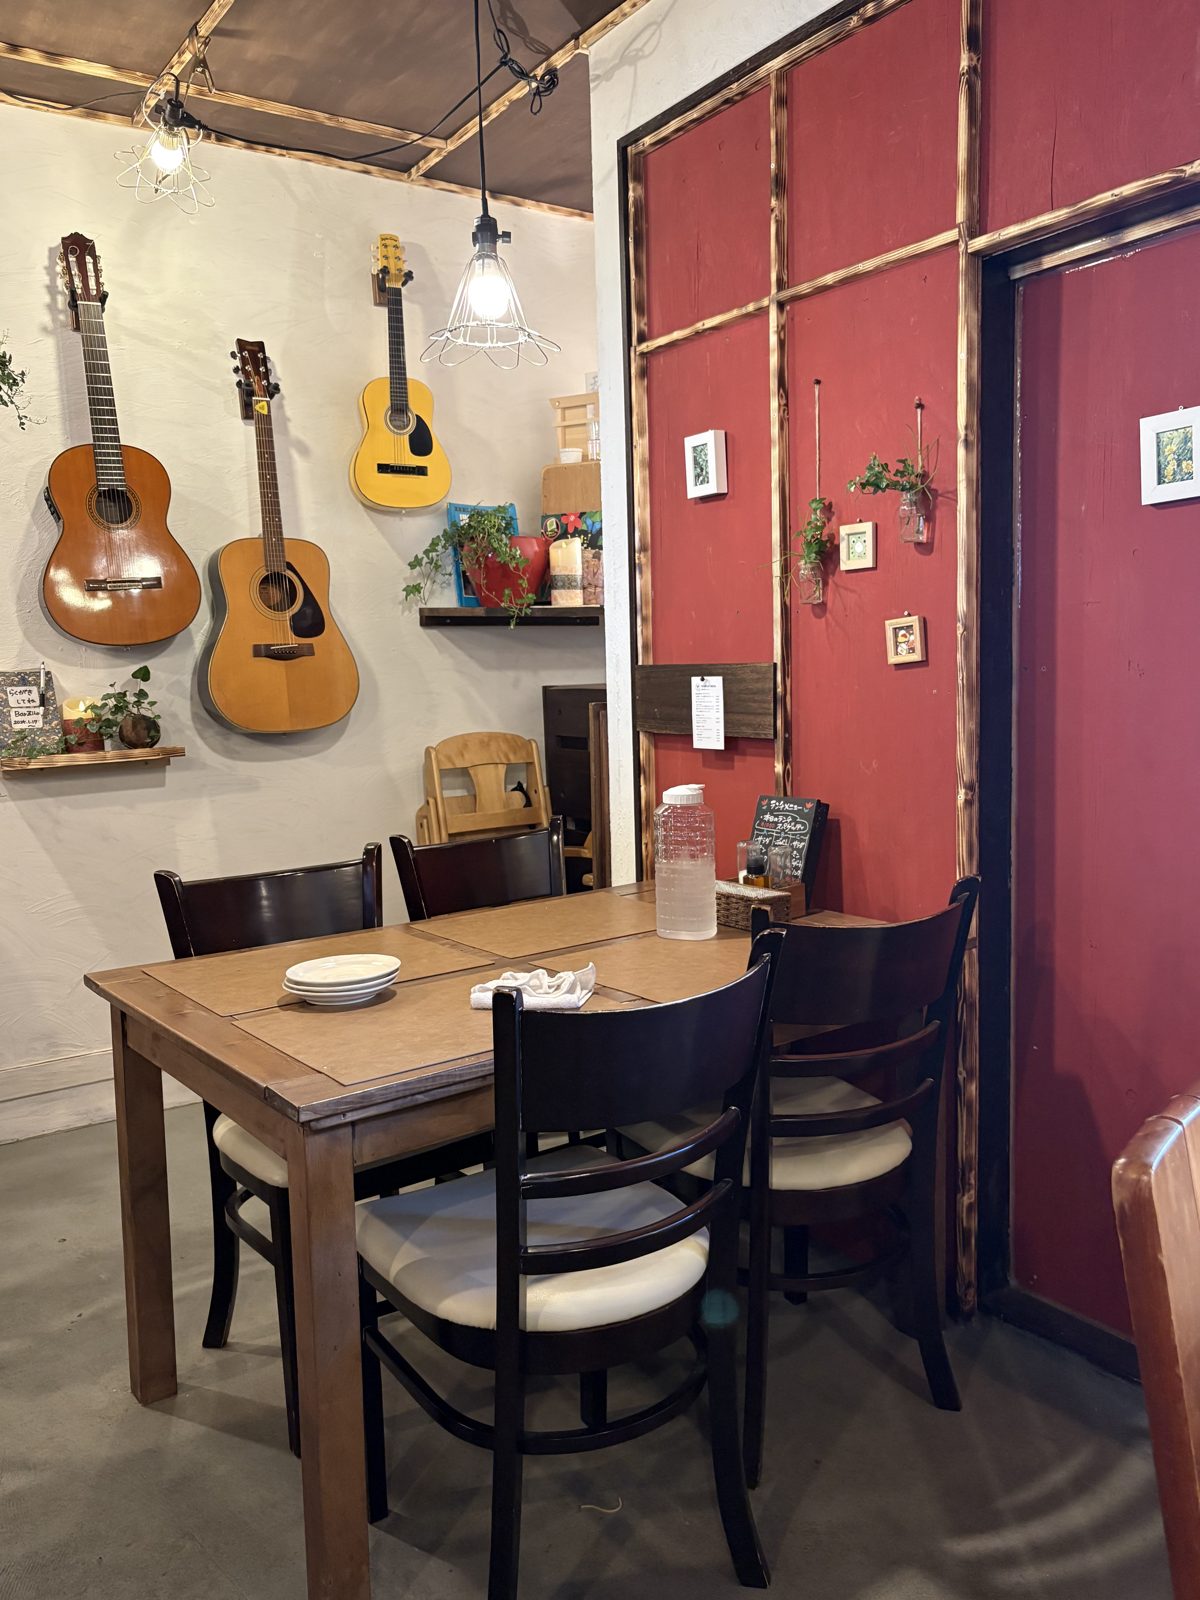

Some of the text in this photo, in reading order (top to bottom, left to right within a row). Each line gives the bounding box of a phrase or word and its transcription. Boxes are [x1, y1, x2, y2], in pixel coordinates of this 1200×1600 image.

[16, 697, 36, 705] してね
[770, 800, 803, 811] ランチメニュー
